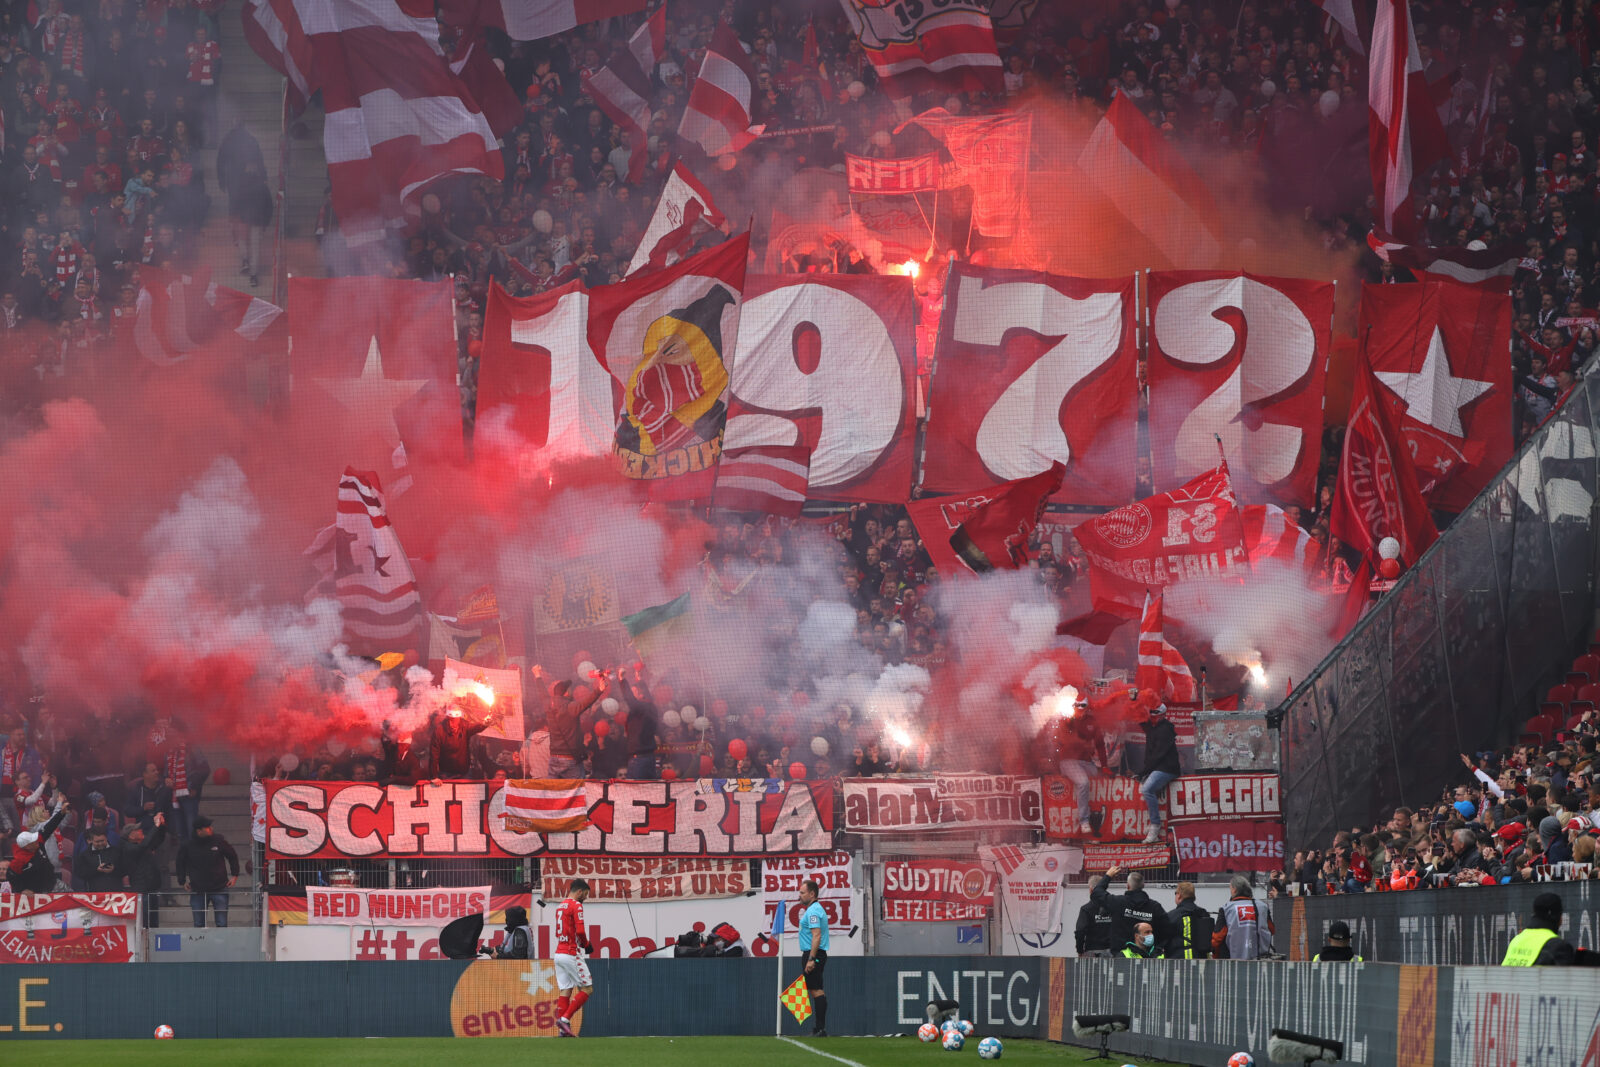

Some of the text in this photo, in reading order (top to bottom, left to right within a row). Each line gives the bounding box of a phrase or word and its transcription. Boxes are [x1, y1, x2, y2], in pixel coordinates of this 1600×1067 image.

[1169, 777, 1280, 816] COLEGIO
[1179, 834, 1284, 859] Rhoibazis
[543, 858, 747, 875] AUSGESPERRTE
[765, 852, 850, 870] WIR SIND
[640, 875, 682, 898] BEI
[691, 873, 744, 894] UNS
[765, 870, 850, 892] BEI DIR
[313, 892, 360, 918] RED
[0, 978, 64, 1031] E.
